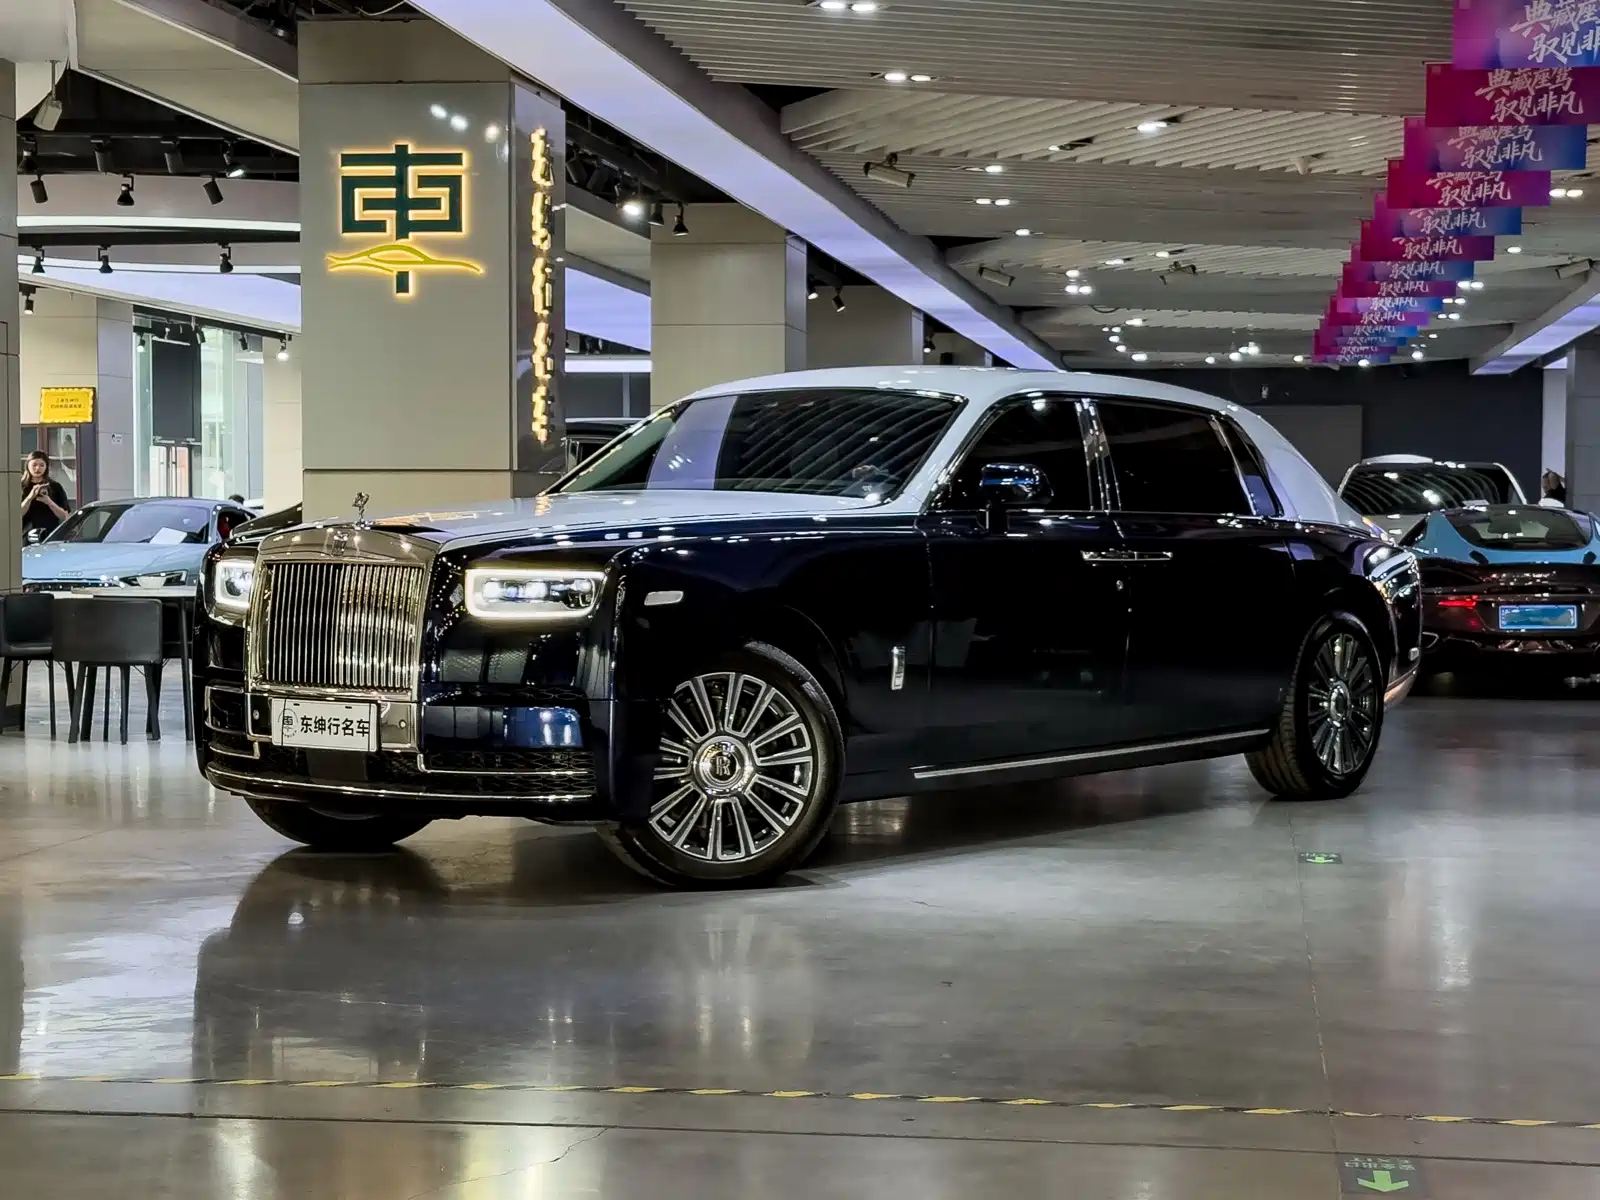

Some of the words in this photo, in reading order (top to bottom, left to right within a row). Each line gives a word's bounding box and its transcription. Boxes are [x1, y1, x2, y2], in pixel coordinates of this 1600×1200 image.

[1510, 0, 1600, 38] 典藏座
[1474, 67, 1573, 101] 典藏座驾
[1490, 90, 1584, 123] 驭见非凡
[1460, 141, 1543, 169] 驭见非凡
[1438, 182, 1512, 207] 驭见非凡
[1420, 211, 1486, 235] 驭见非凡
[1402, 236, 1463, 260] 驭见非凡
[1389, 260, 1445, 279] 驭见非凡
[1377, 280, 1429, 297] 驭见非凡
[300, 715, 370, 737] 东绅行名车
